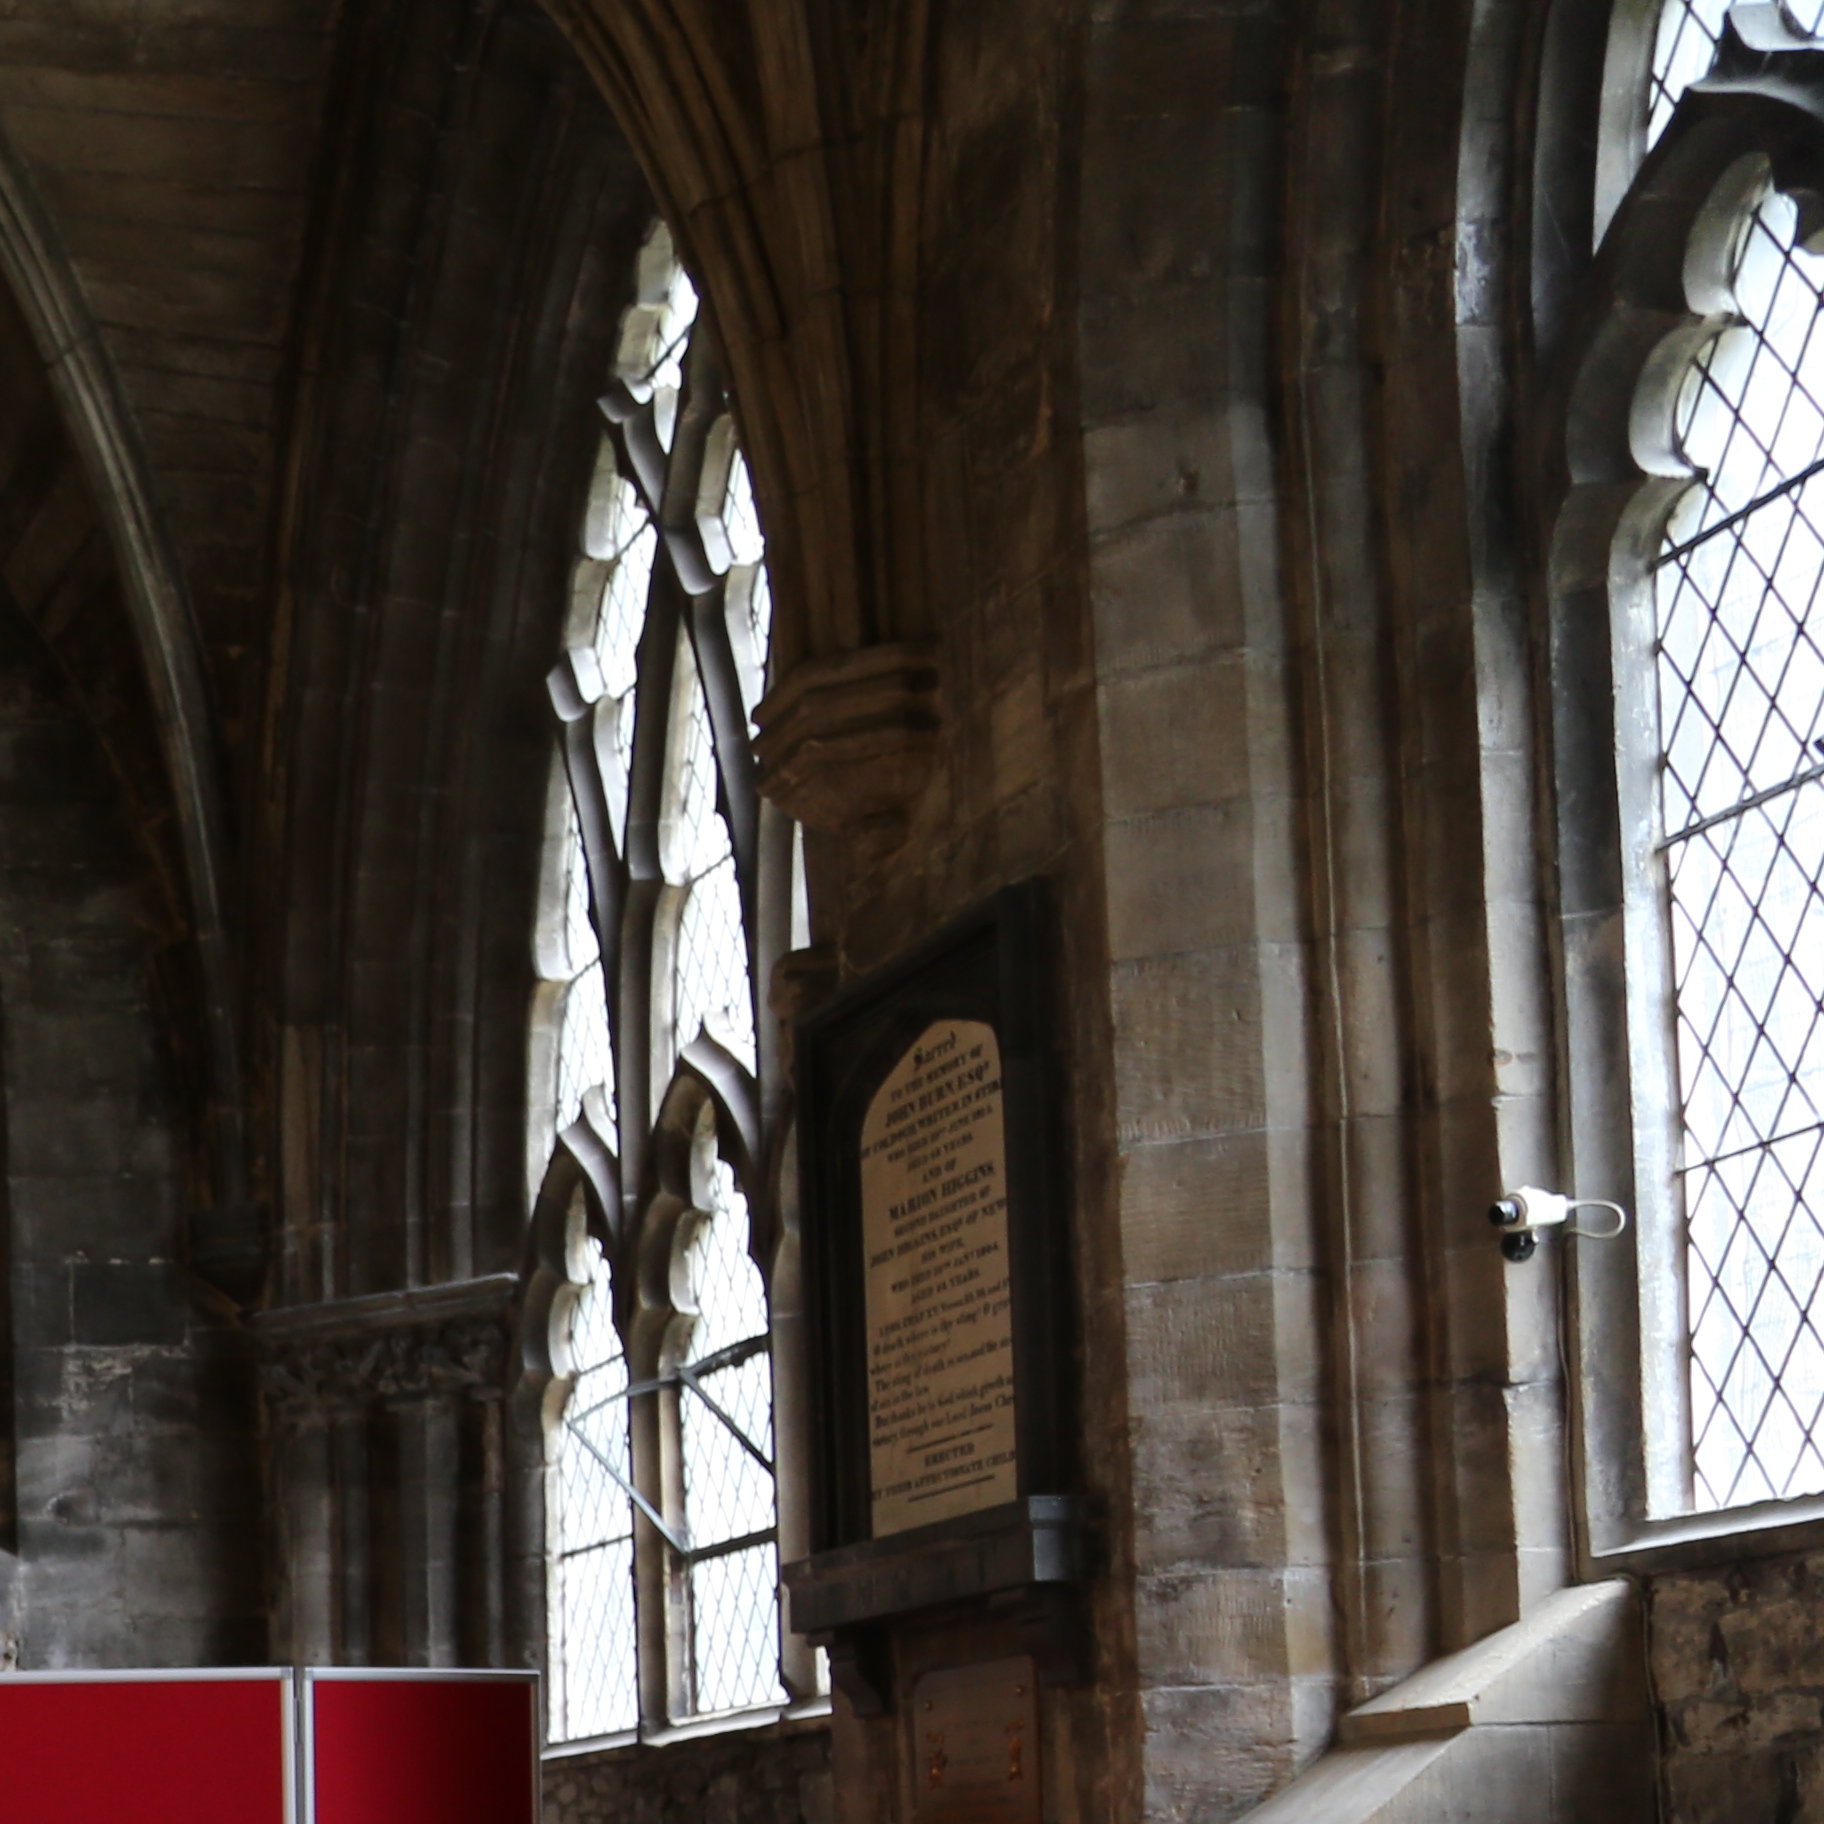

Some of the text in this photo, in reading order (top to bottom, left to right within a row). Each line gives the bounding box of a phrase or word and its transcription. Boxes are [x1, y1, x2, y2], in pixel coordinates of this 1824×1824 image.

[913, 1030, 957, 1072] Sacred
[926, 1054, 966, 1083] MEMORY
[886, 1101, 915, 1128] JOHN
[918, 1081, 954, 1111] BURN
[923, 1157, 956, 1183] AND OF
[889, 1161, 995, 1220] MARION HIGGINS
[925, 1442, 974, 1466] ERECTED
